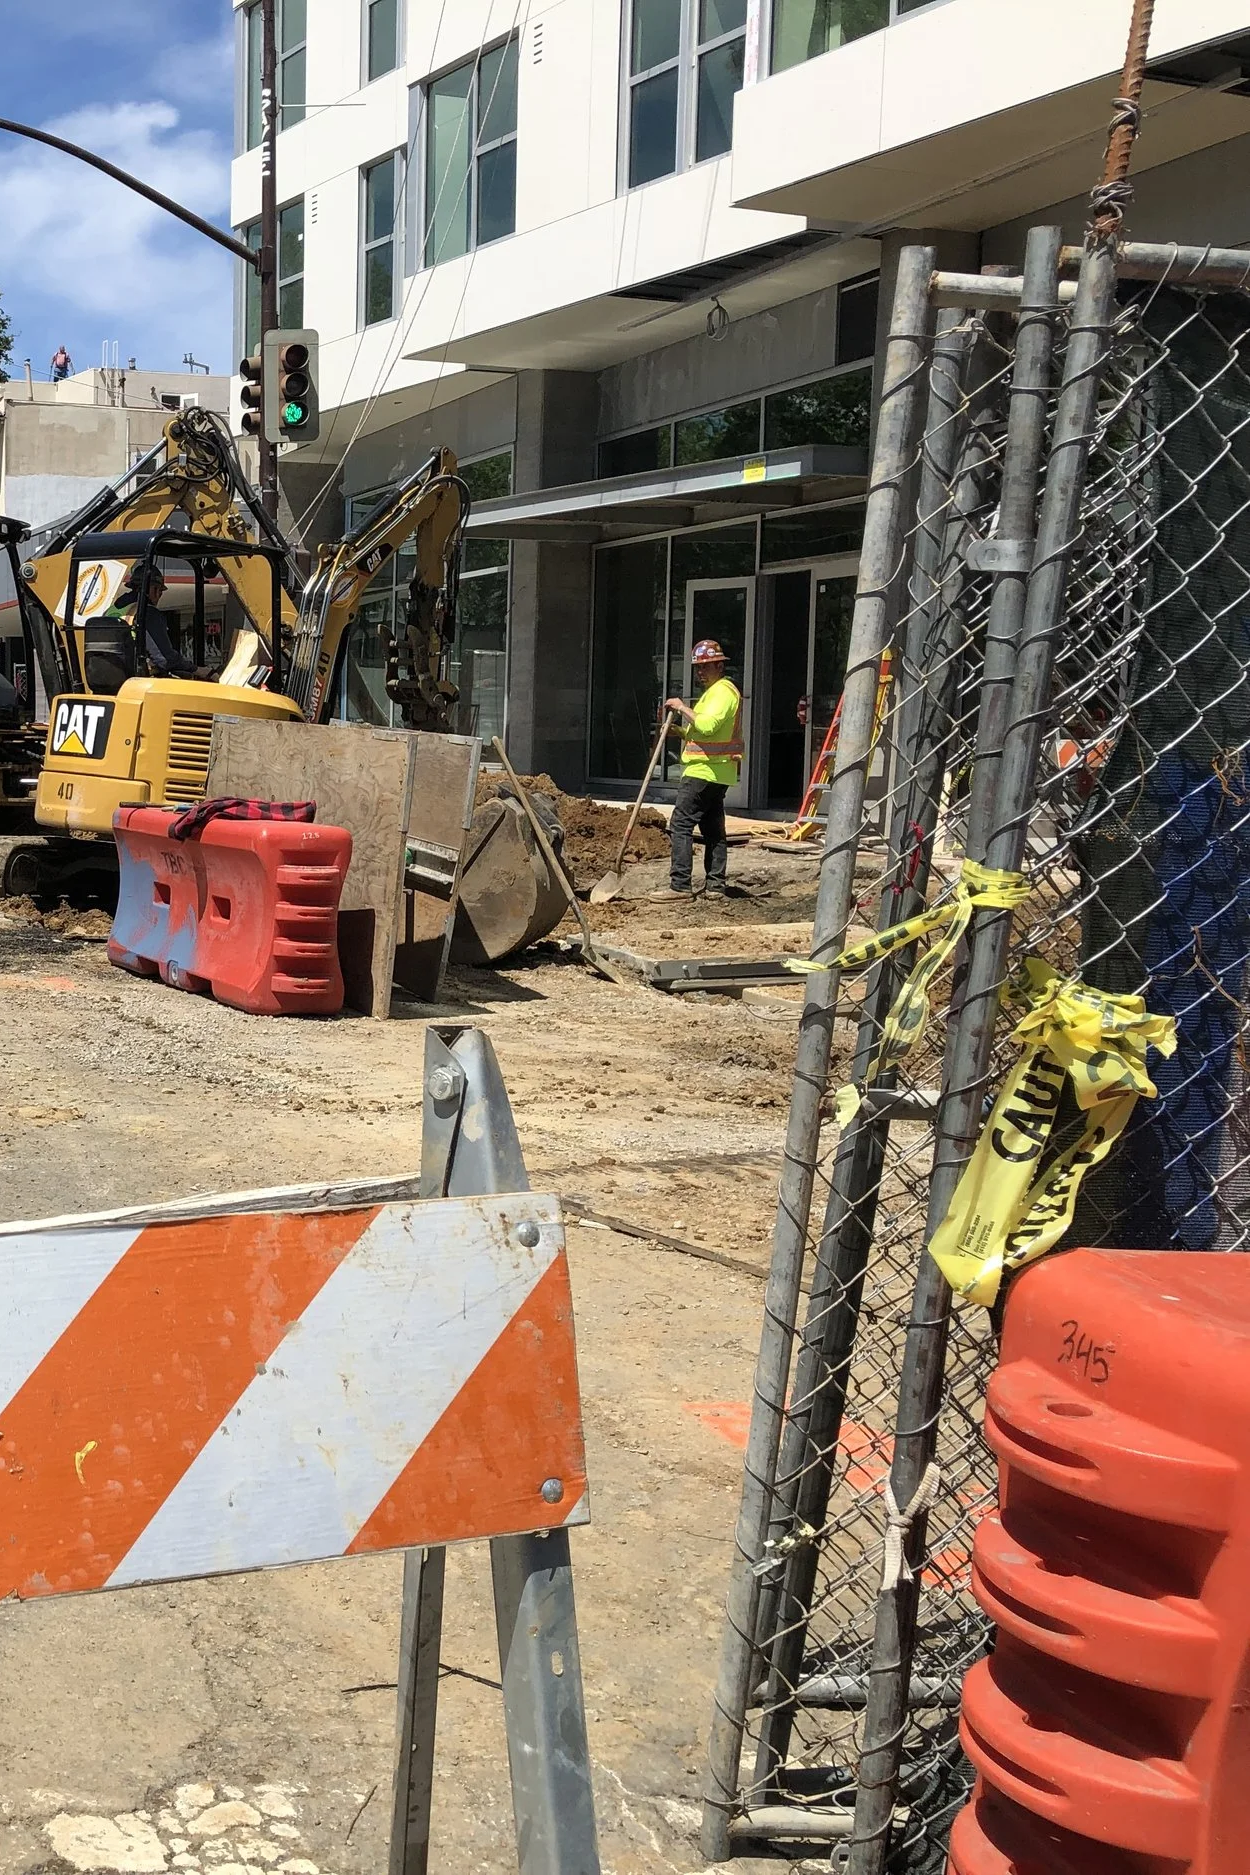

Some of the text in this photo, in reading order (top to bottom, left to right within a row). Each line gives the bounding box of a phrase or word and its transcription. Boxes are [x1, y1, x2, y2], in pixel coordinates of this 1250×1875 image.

[366, 547, 382, 572] CAT
[53, 703, 106, 755] CAT
[57, 782, 74, 801] 40
[991, 1051, 1067, 1163] CAUT
[1057, 1320, 1116, 1383] 345
